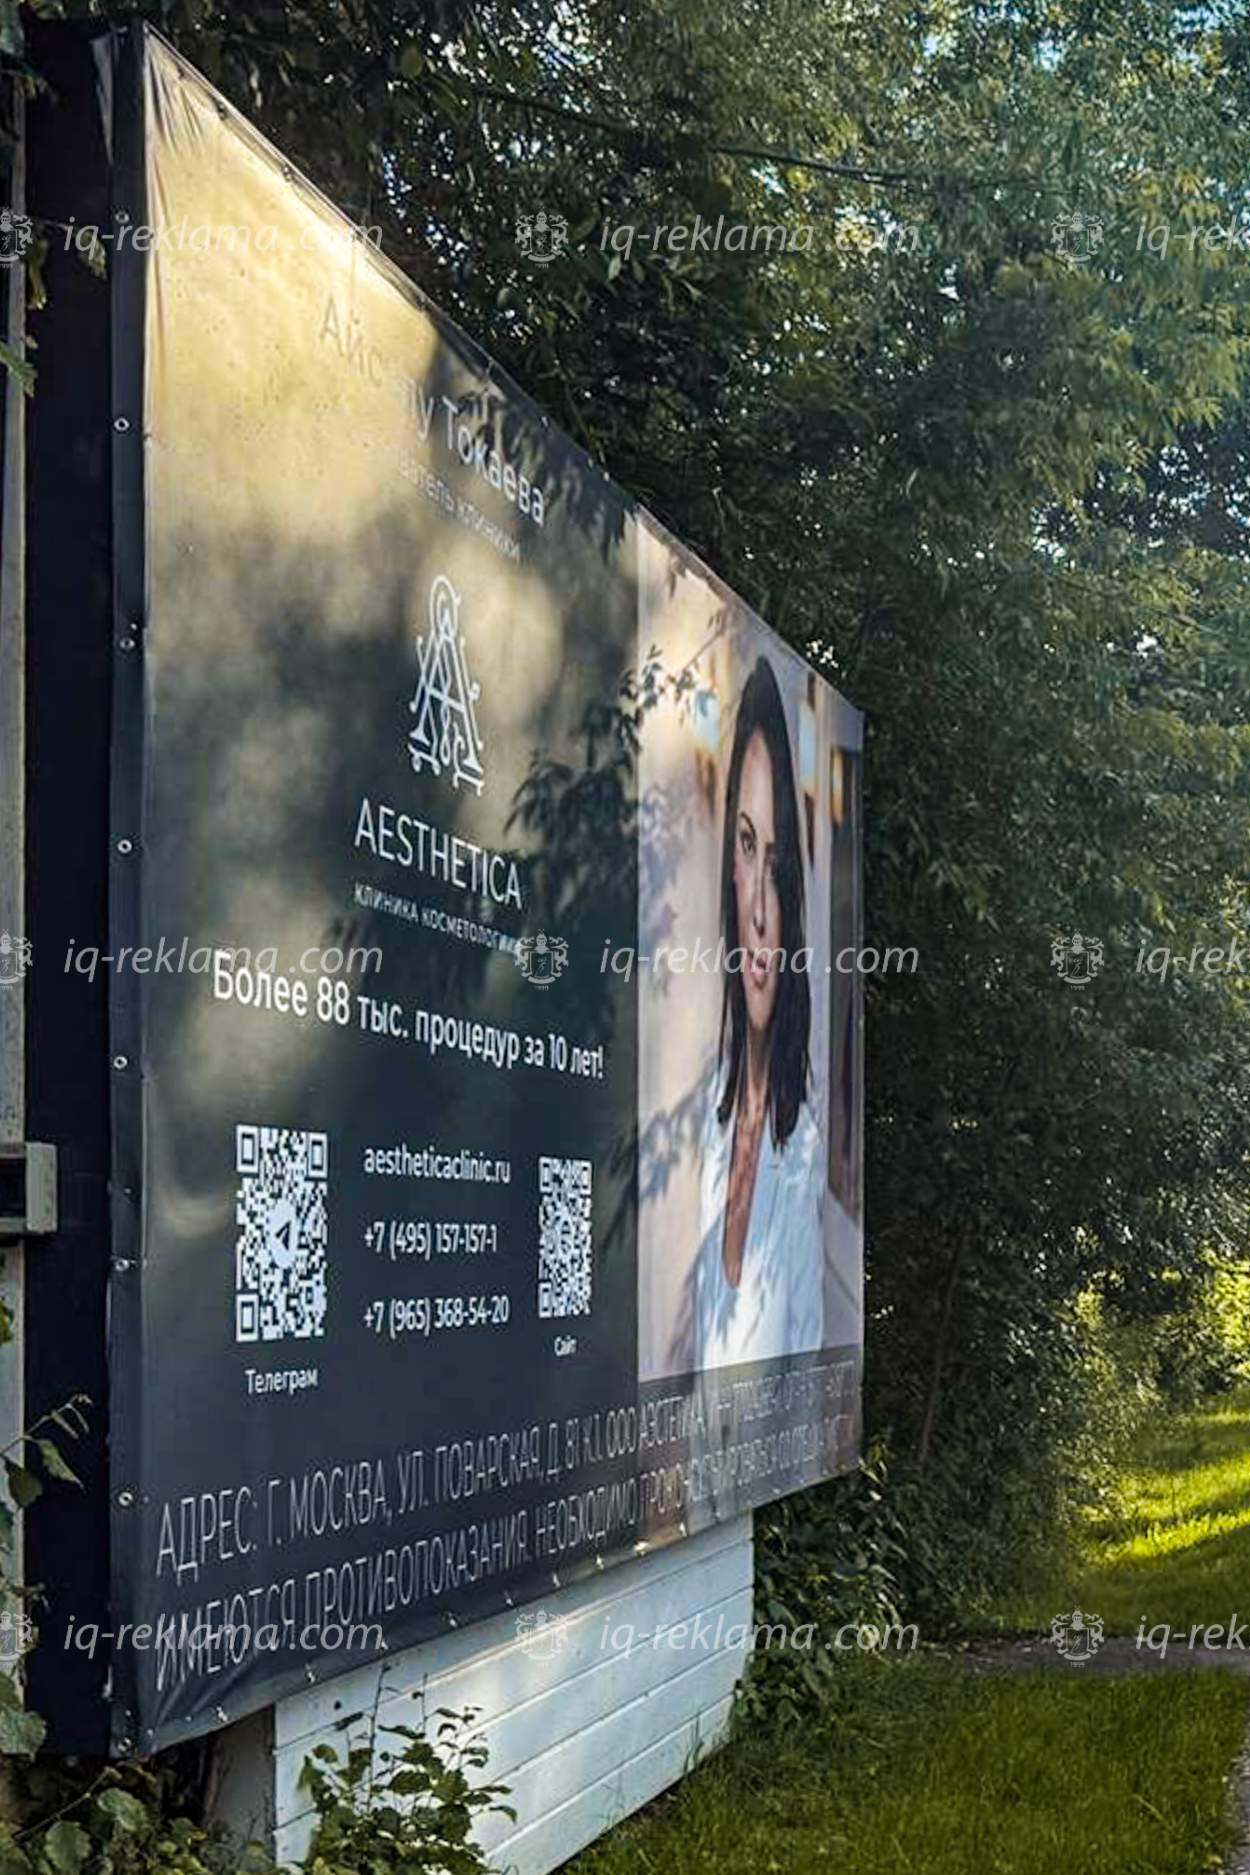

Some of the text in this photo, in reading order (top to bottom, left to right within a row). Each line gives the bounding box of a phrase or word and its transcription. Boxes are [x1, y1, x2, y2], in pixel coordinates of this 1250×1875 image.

[442, 396, 543, 526] Токаева
[355, 798, 522, 909] AESTHETICA
[355, 882, 419, 923] КЛИНИКА
[213, 951, 604, 1079] Более 88 тыс. процедур за 10 лет!
[364, 1145, 511, 1185] aestheticaclinic.ru
[364, 1221, 498, 1260] +7 (495) 157-157-1
[364, 1295, 510, 1339] +7 (965) 368-54-20
[554, 1335, 577, 1356] Сайт
[245, 1365, 318, 1395] Телеграм
[290, 1459, 393, 1540] МОСКВА,
[156, 1579, 295, 1692] ИМЕЮТСЯ
[536, 1477, 637, 1558] НЕОБХОДИМО
